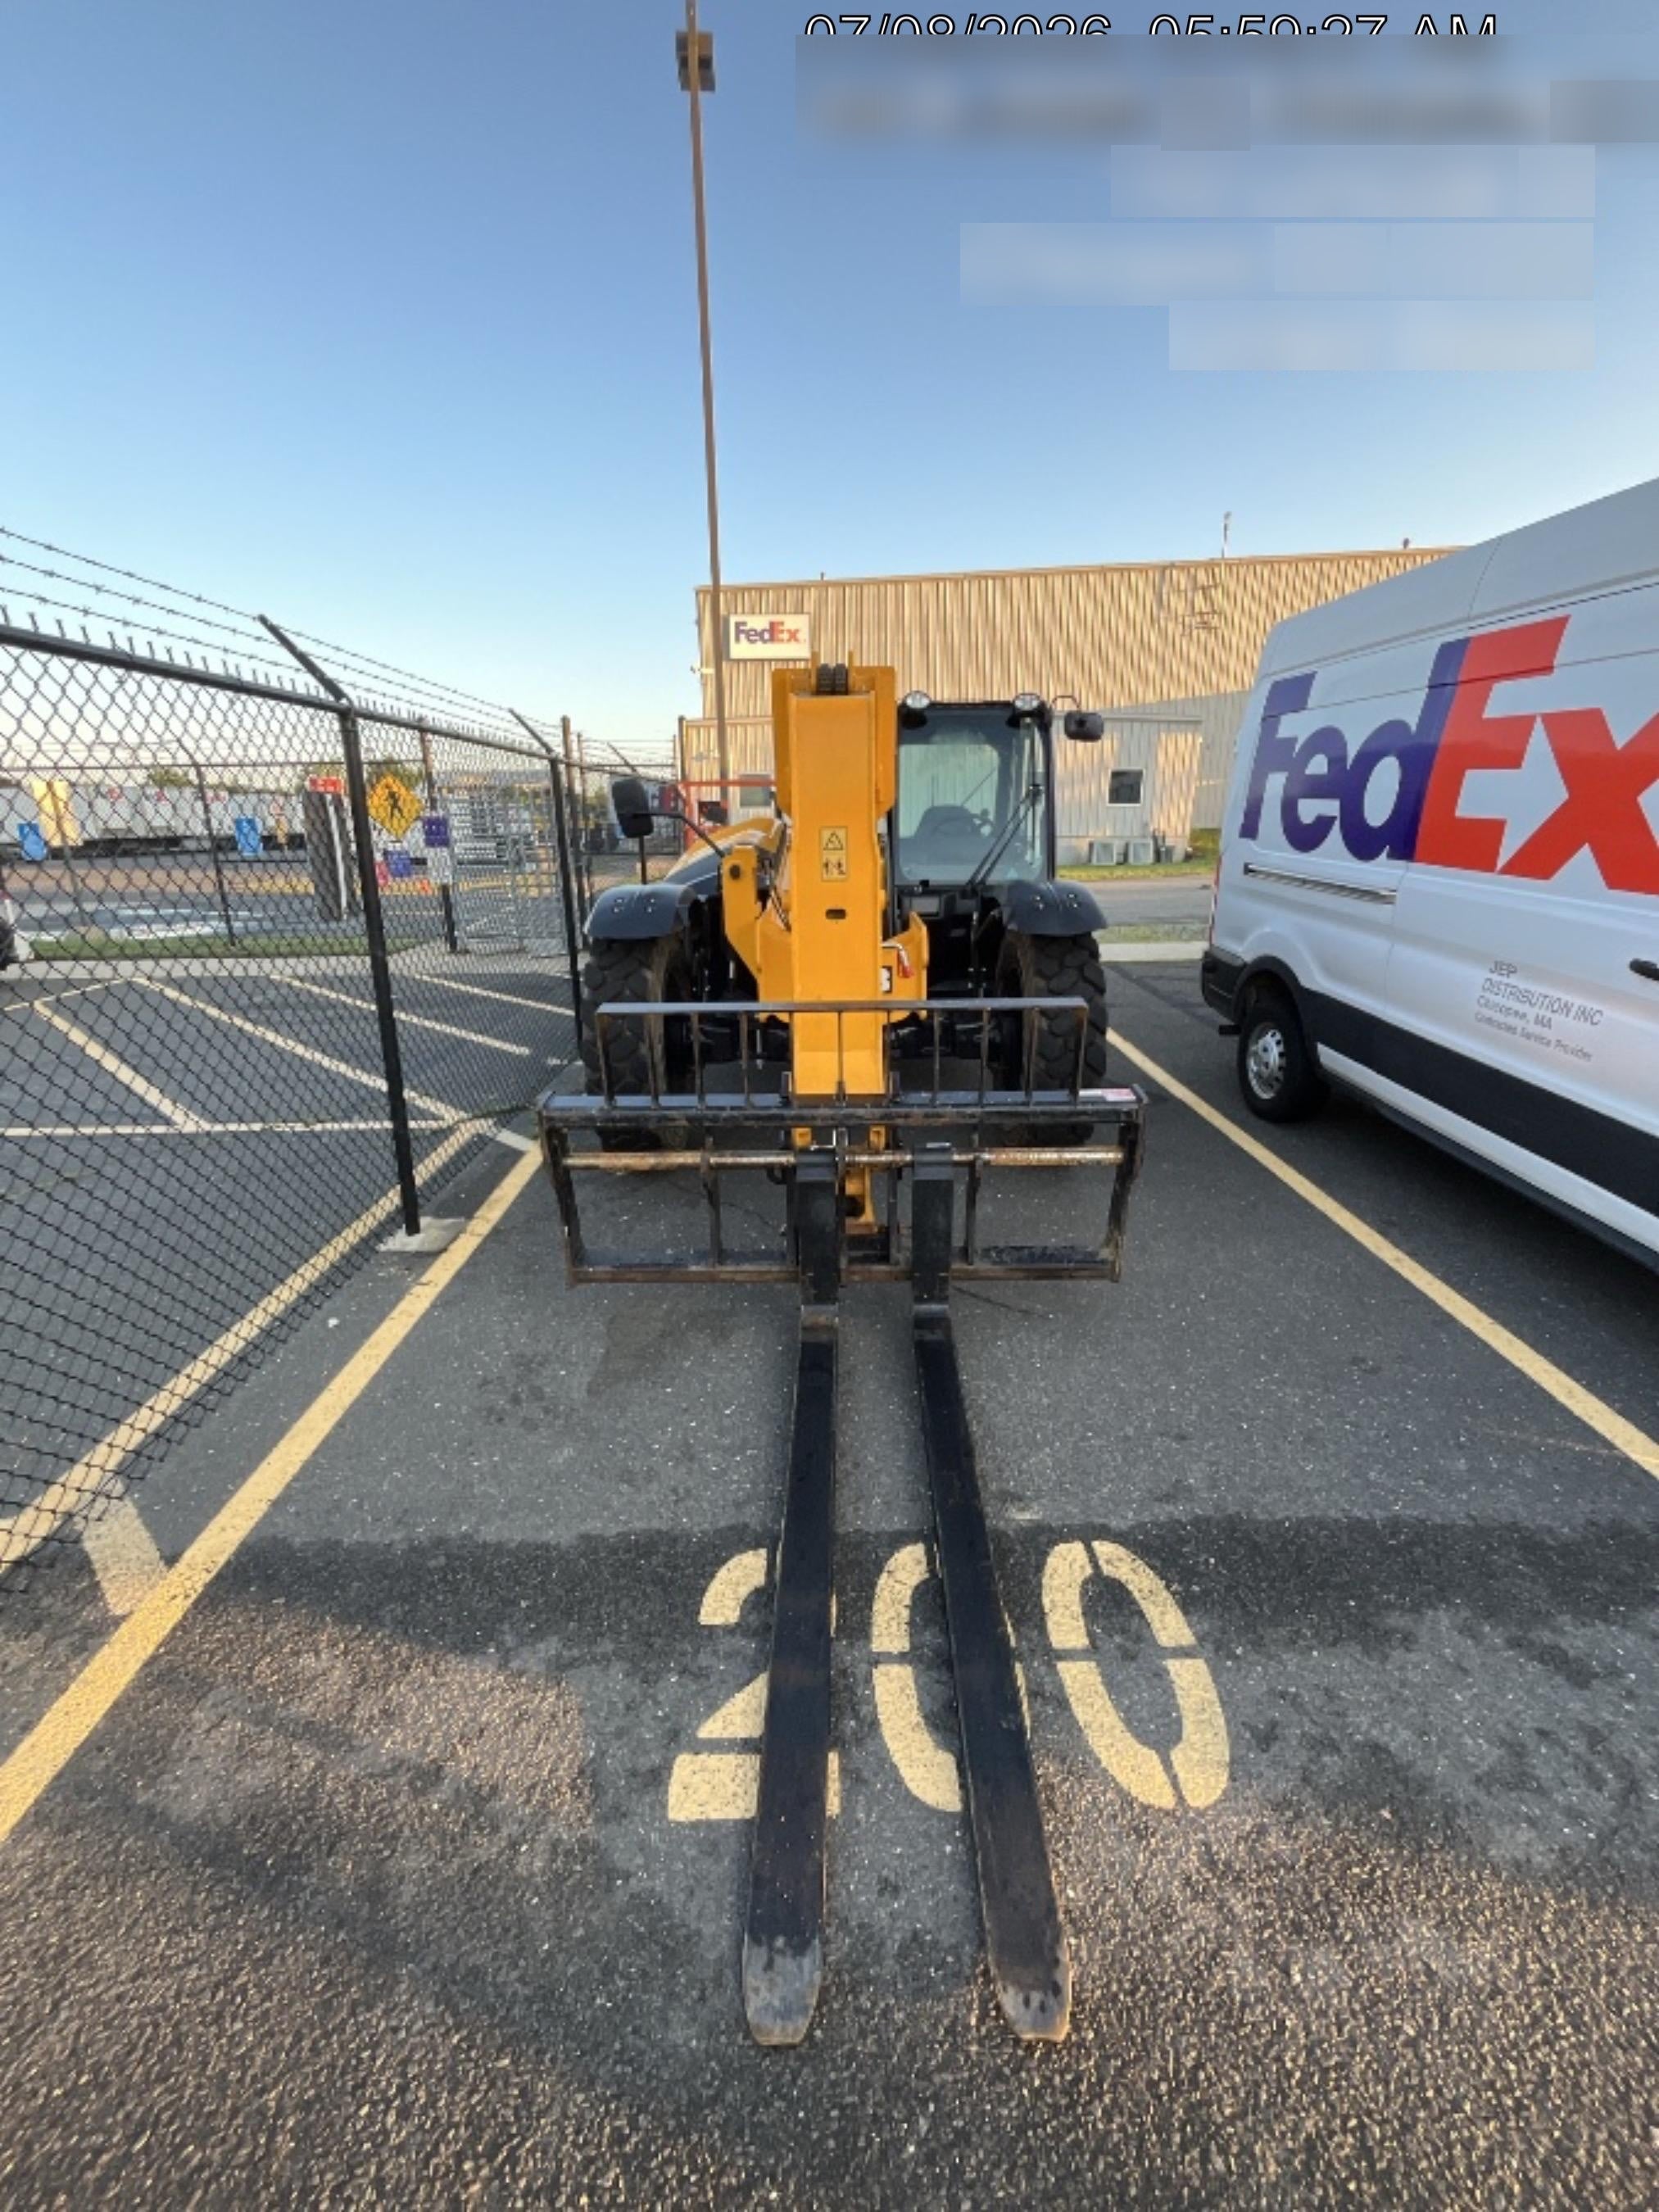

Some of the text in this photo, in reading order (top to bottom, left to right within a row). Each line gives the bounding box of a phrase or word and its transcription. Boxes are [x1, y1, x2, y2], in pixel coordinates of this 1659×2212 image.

[734, 621, 800, 643] FedEx
[1240, 615, 1659, 896] FedEx
[1481, 977, 1603, 1026] DISTRIBUTION INC
